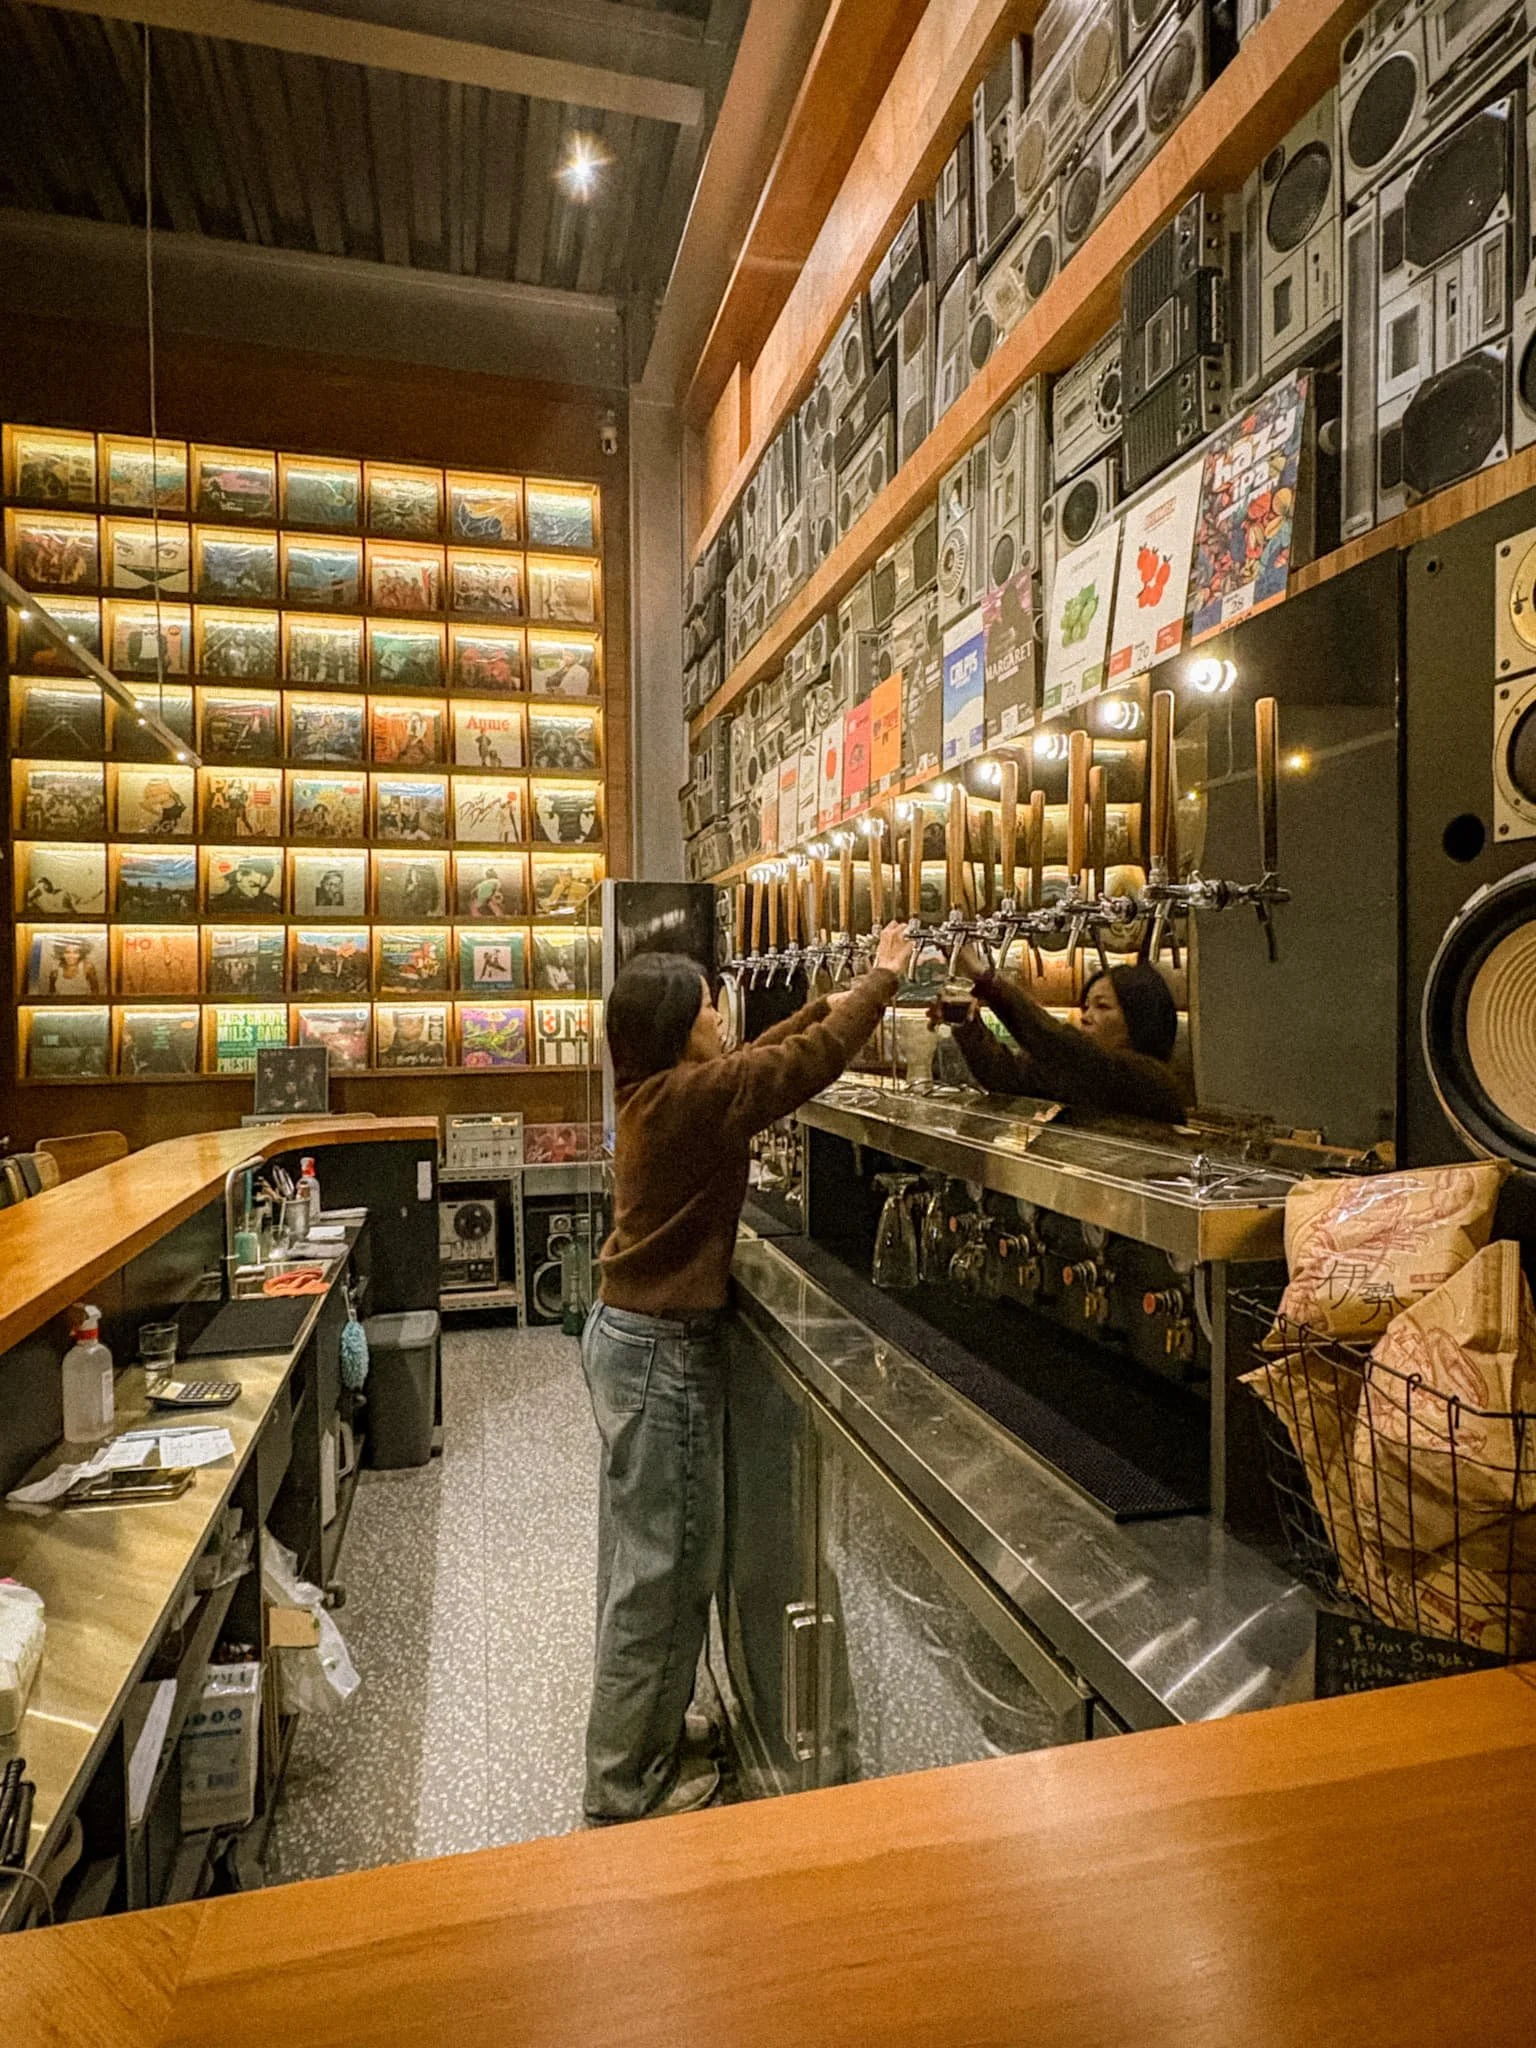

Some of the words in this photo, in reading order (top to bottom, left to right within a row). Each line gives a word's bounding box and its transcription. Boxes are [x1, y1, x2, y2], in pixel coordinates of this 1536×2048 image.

[1212, 406, 1296, 493] hazy
[985, 639, 1033, 683] MARGARET
[466, 716, 509, 731] Annie
[217, 1025, 253, 1041] MILES
[258, 1025, 288, 1041] DAVIS
[1316, 1260, 1433, 1325] 伊勢
